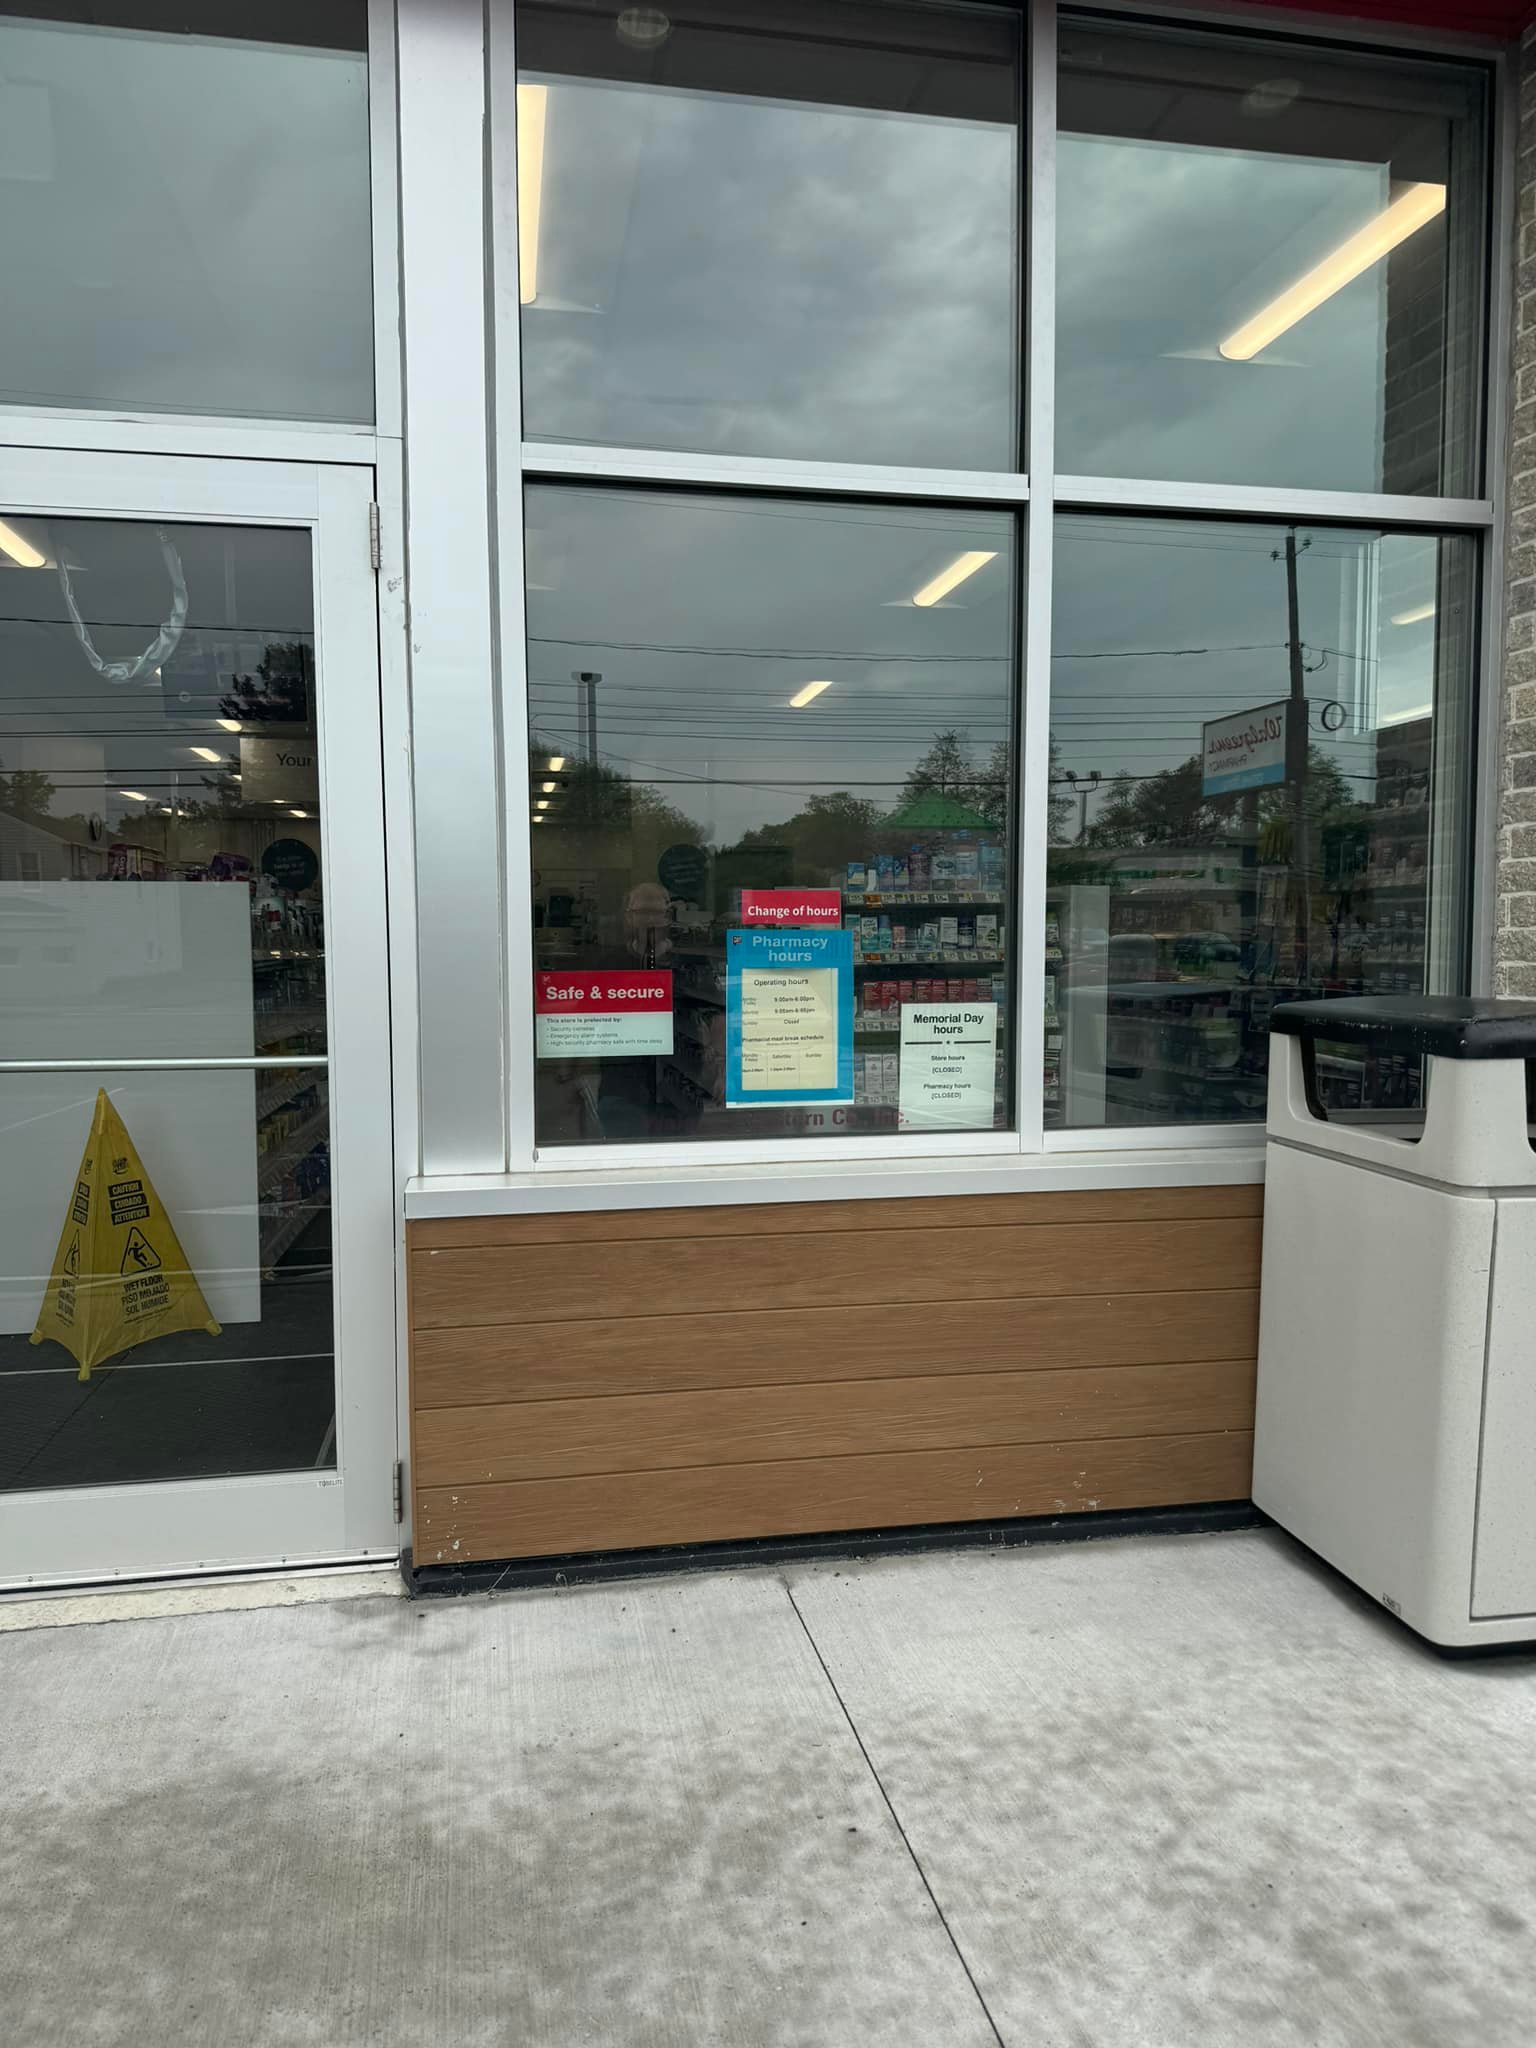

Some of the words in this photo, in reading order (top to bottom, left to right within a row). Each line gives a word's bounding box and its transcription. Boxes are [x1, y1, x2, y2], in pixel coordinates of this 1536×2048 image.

[276, 753, 313, 768] Your
[747, 905, 790, 919] Change
[792, 905, 804, 916] of
[806, 905, 839, 916] hours
[752, 935, 829, 950] Pharmacy
[768, 949, 813, 962] hours
[753, 979, 787, 987] Operating
[546, 986, 585, 1000] Safe
[590, 985, 602, 1000] &
[607, 987, 665, 999] secure
[913, 1013, 961, 1024] Memorial
[963, 1013, 984, 1025] Day
[933, 1025, 964, 1034] hours
[111, 1182, 140, 1195] CAUTION
[114, 1195, 142, 1209] CUIDADO
[114, 1208, 147, 1224] ATTENTION
[123, 1280, 140, 1292] WET
[140, 1274, 163, 1288] FLOOR
[121, 1292, 139, 1305] PISO
